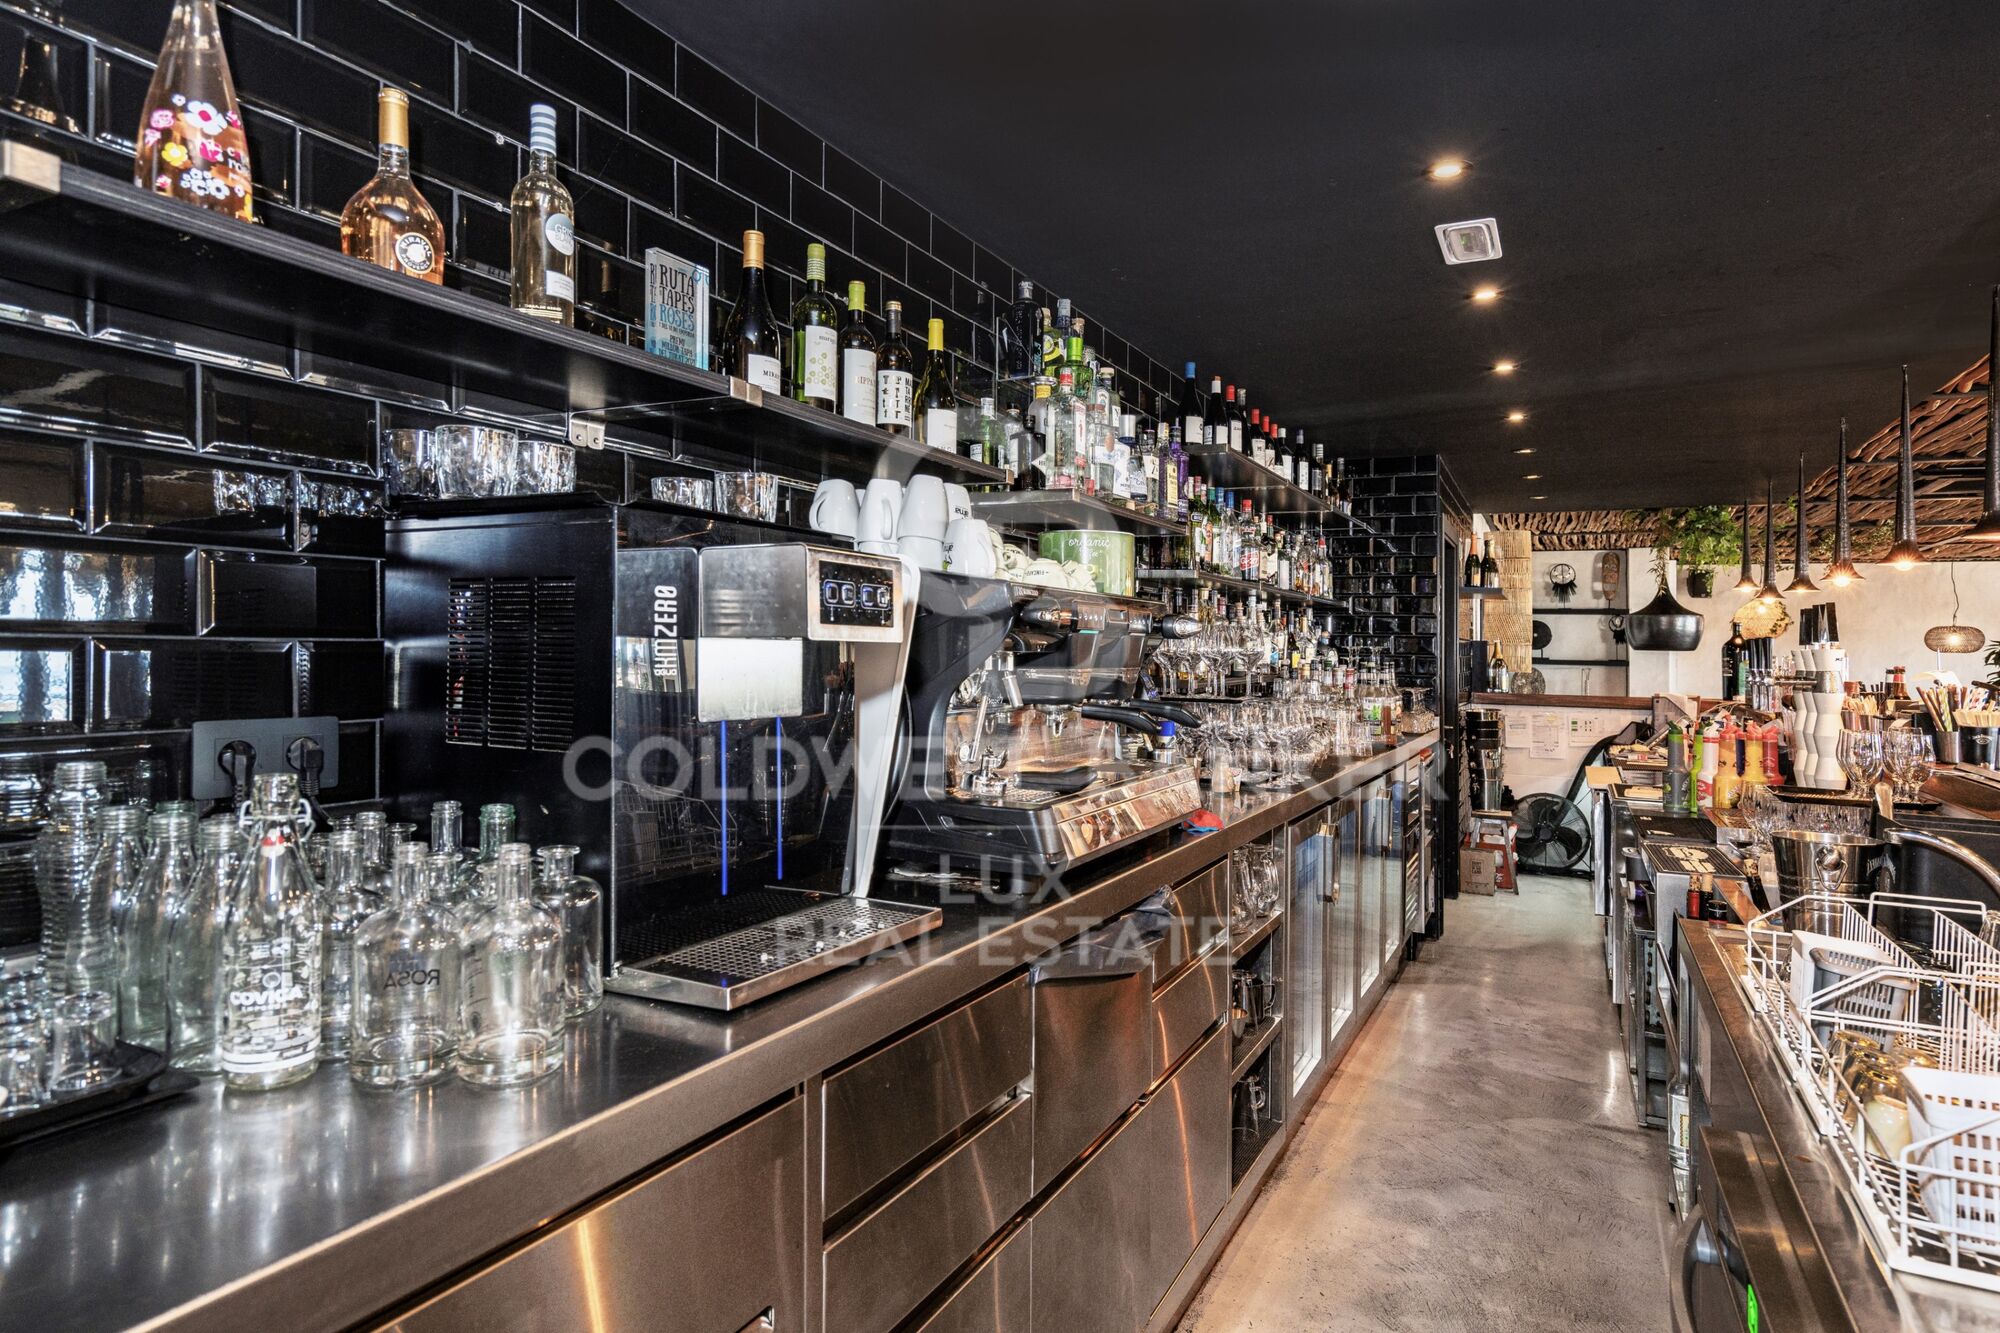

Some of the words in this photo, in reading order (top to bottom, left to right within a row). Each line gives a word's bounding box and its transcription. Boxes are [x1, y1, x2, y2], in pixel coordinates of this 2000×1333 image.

[659, 264, 695, 297] RUTA
[659, 286, 695, 314] TAPES
[659, 303, 695, 331] ROSES
